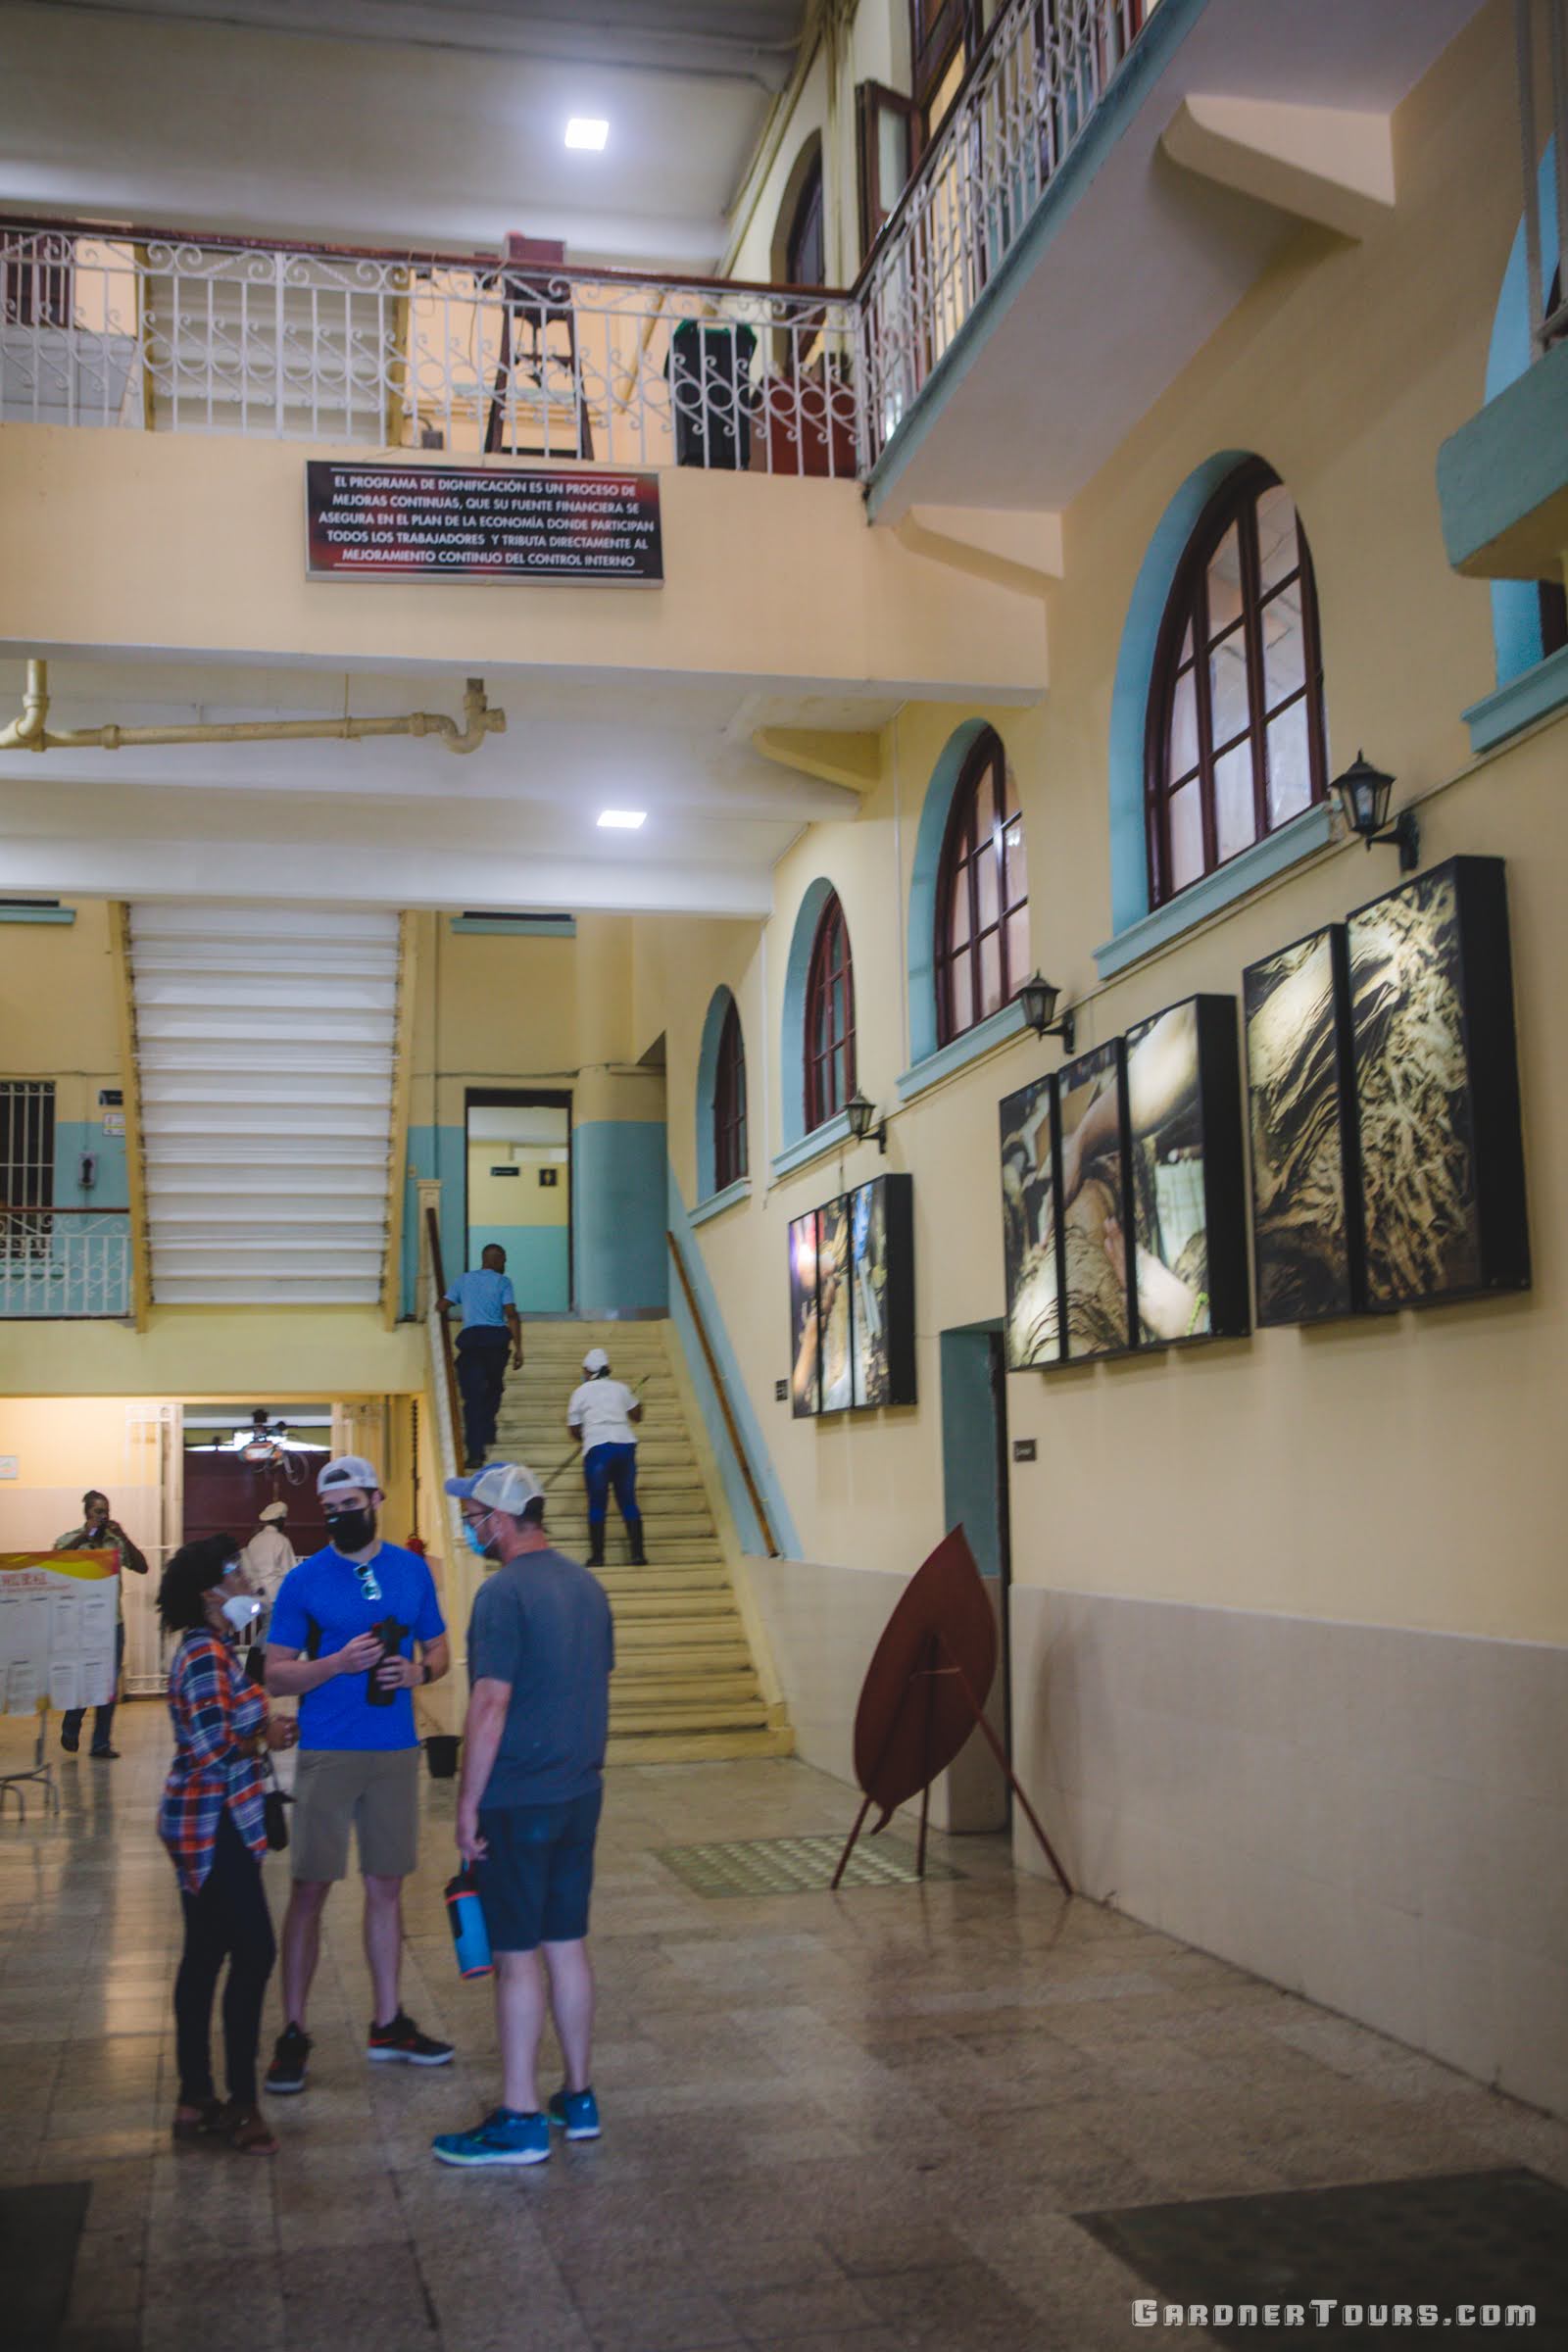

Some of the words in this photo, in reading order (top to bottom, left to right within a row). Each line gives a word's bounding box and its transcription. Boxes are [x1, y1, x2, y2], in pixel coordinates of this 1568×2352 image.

[334, 475, 347, 488] EL
[350, 476, 418, 490] PROGRAMA
[420, 478, 435, 490] DE
[438, 478, 526, 493] DIGNIFICACIÓN
[529, 482, 543, 493] ES
[545, 483, 564, 494] UN
[565, 483, 619, 497] PROCESO
[621, 485, 636, 497] DE
[331, 494, 388, 507] MEJORAS
[390, 496, 463, 510] CONTINUAS,
[466, 498, 490, 510] QUE
[493, 498, 509, 511] SU
[511, 499, 554, 512] FUENTE
[556, 500, 623, 514] FINANCIERA
[625, 503, 640, 514] SE
[318, 511, 374, 524] ASEGURA
[377, 514, 393, 525] EN
[396, 514, 409, 525] EL
[412, 514, 442, 526] PLAN
[445, 515, 460, 526] DE
[463, 515, 477, 527] LA
[480, 515, 544, 529] ECONOMÍA
[547, 517, 588, 530] DONDE
[591, 519, 655, 532] PARTICIPAN
[326, 530, 368, 543] TODOS
[371, 531, 393, 543] LOS
[396, 532, 485, 545] TRABAJADORES
[491, 534, 500, 545] Y
[502, 534, 547, 547] TRIBUTA
[549, 536, 631, 550] DIRECTAMENTE
[633, 538, 649, 550] AL
[342, 549, 437, 563] MEJORAMIENTO
[438, 551, 503, 564] CONTINUO
[505, 553, 525, 564] DEL
[527, 553, 582, 565] CONTROL
[584, 555, 636, 567] INTERNO
